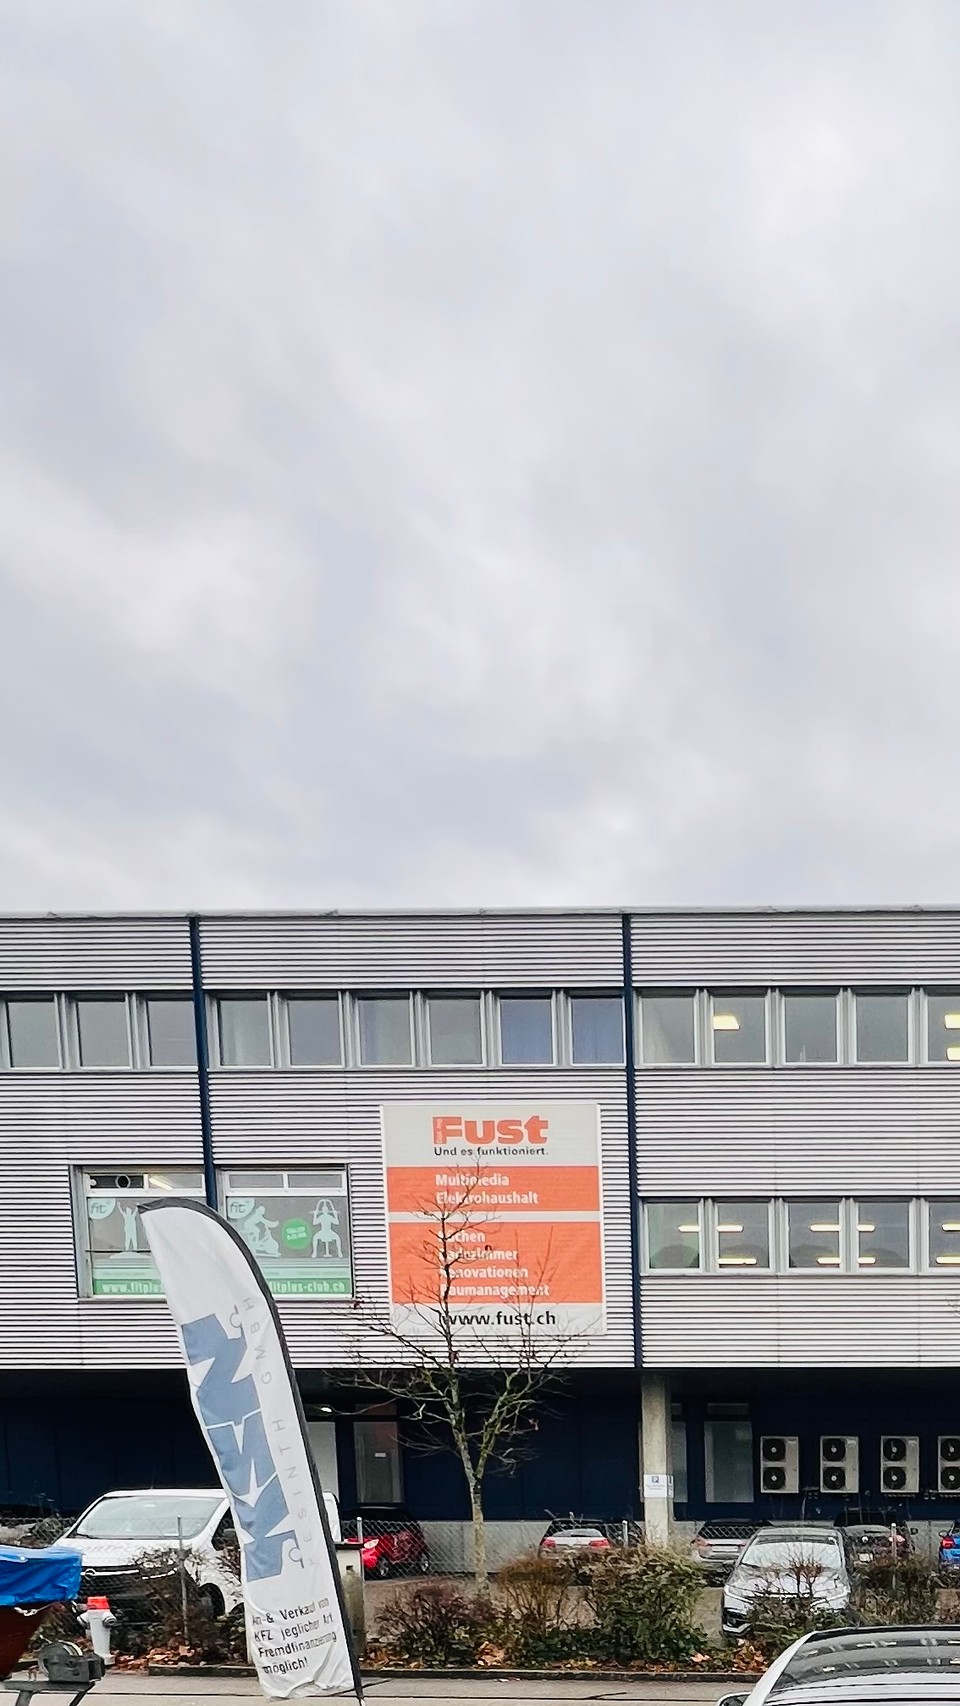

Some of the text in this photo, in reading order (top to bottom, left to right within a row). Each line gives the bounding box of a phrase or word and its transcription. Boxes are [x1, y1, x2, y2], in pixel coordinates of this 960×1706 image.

[432, 1115, 549, 1144] Fust
[434, 1147, 457, 1156] Und
[460, 1148, 473, 1156] es
[435, 1173, 509, 1186] Multimedia
[254, 1629, 274, 1642] KFZ
[262, 1656, 309, 1674] möglich!
